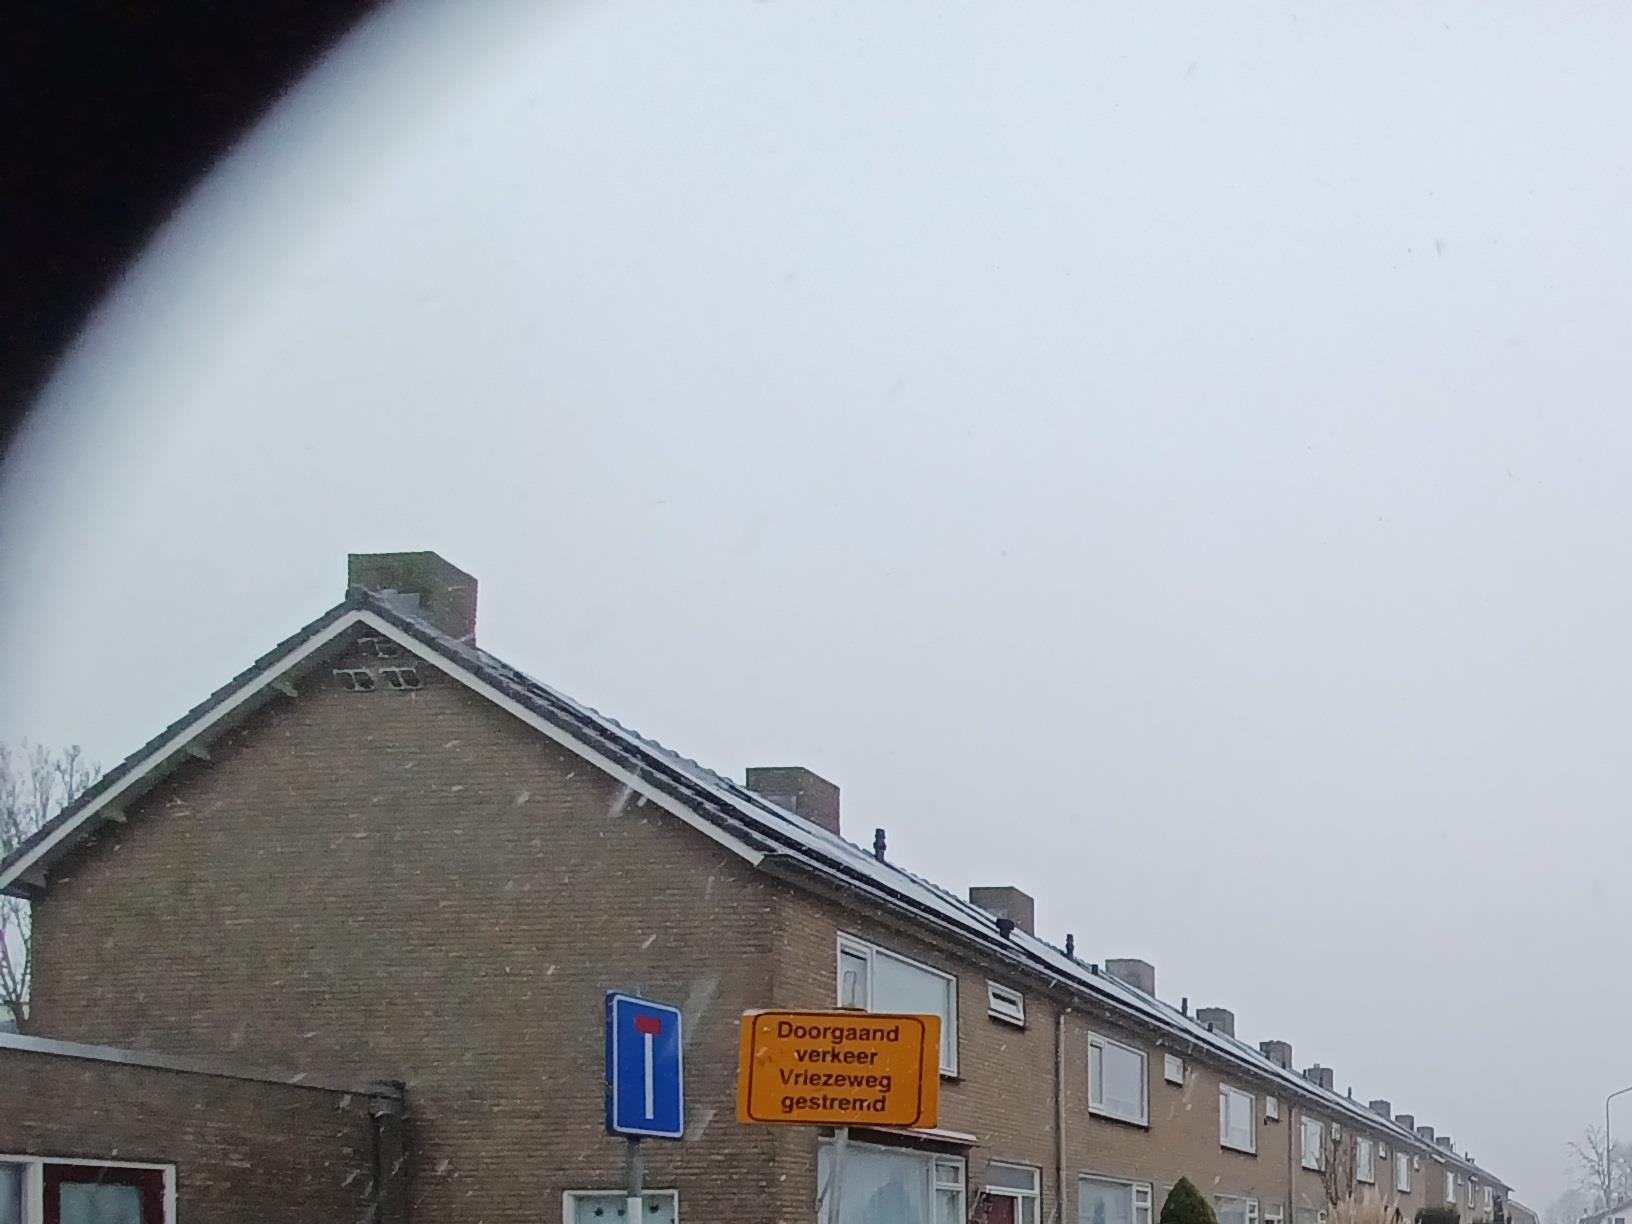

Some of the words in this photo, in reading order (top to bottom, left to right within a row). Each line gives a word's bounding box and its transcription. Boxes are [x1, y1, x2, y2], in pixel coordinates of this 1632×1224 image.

[777, 1020, 900, 1044] Doorgaand
[796, 1047, 878, 1065] verkeer
[779, 1068, 892, 1093] Vriezeweg
[781, 1094, 887, 1114] gestremd
